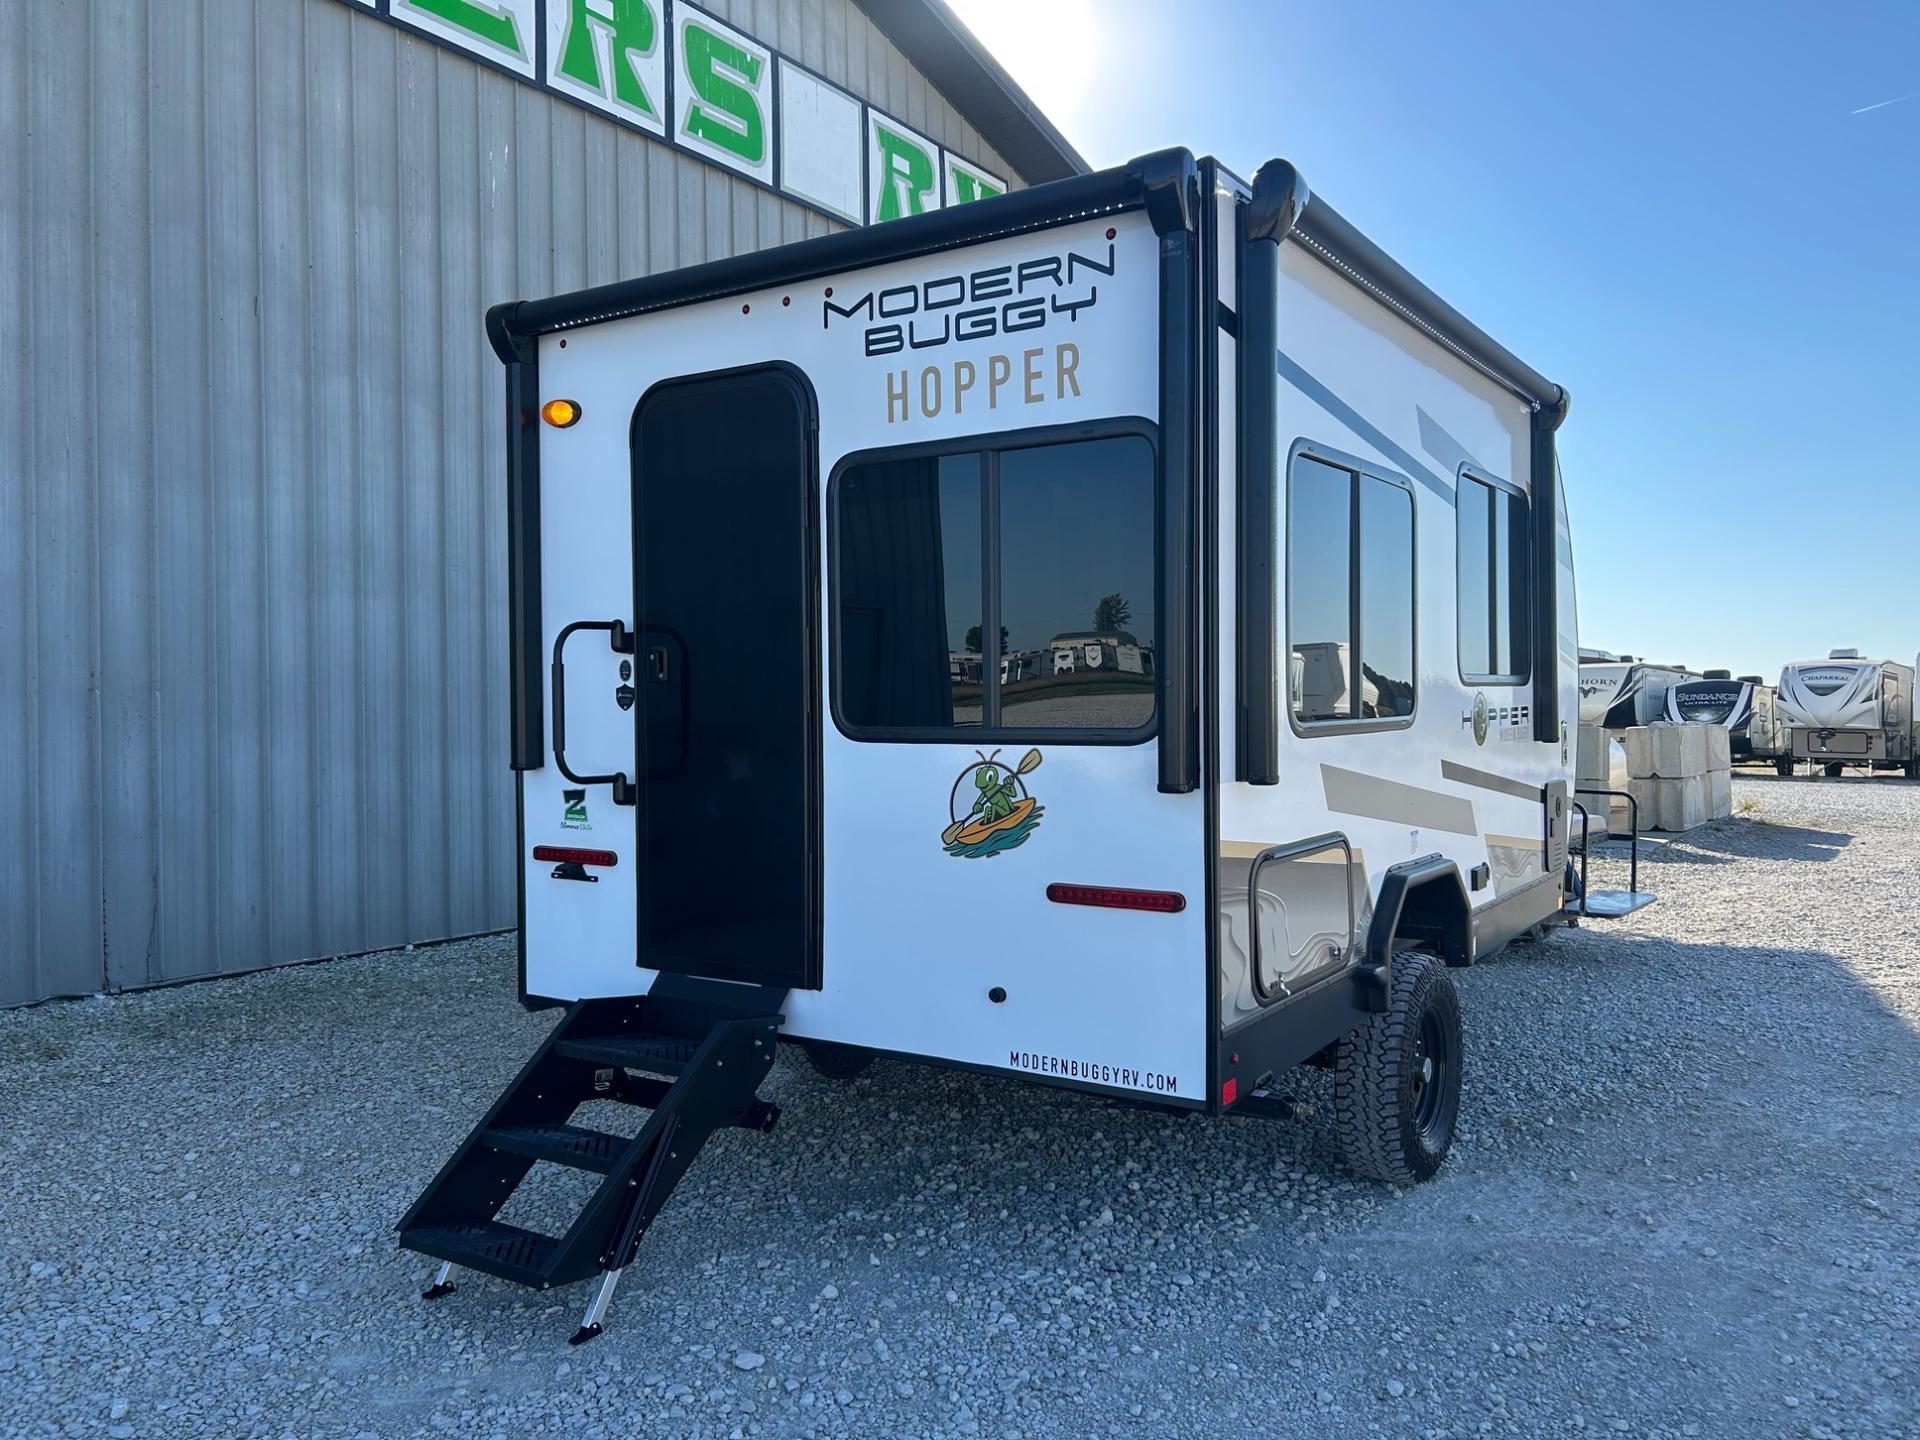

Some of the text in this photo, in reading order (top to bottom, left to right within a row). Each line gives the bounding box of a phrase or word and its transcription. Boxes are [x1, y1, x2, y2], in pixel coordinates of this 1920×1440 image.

[398, 0, 769, 165] RS
[824, 243, 1115, 329] MODERN
[865, 286, 1097, 357] BUGGY
[886, 343, 1081, 424] HOPPER
[1676, 693, 1739, 702] SUNDANCE
[1010, 1050, 1177, 1093] MODERNBUGGYRV.COM
